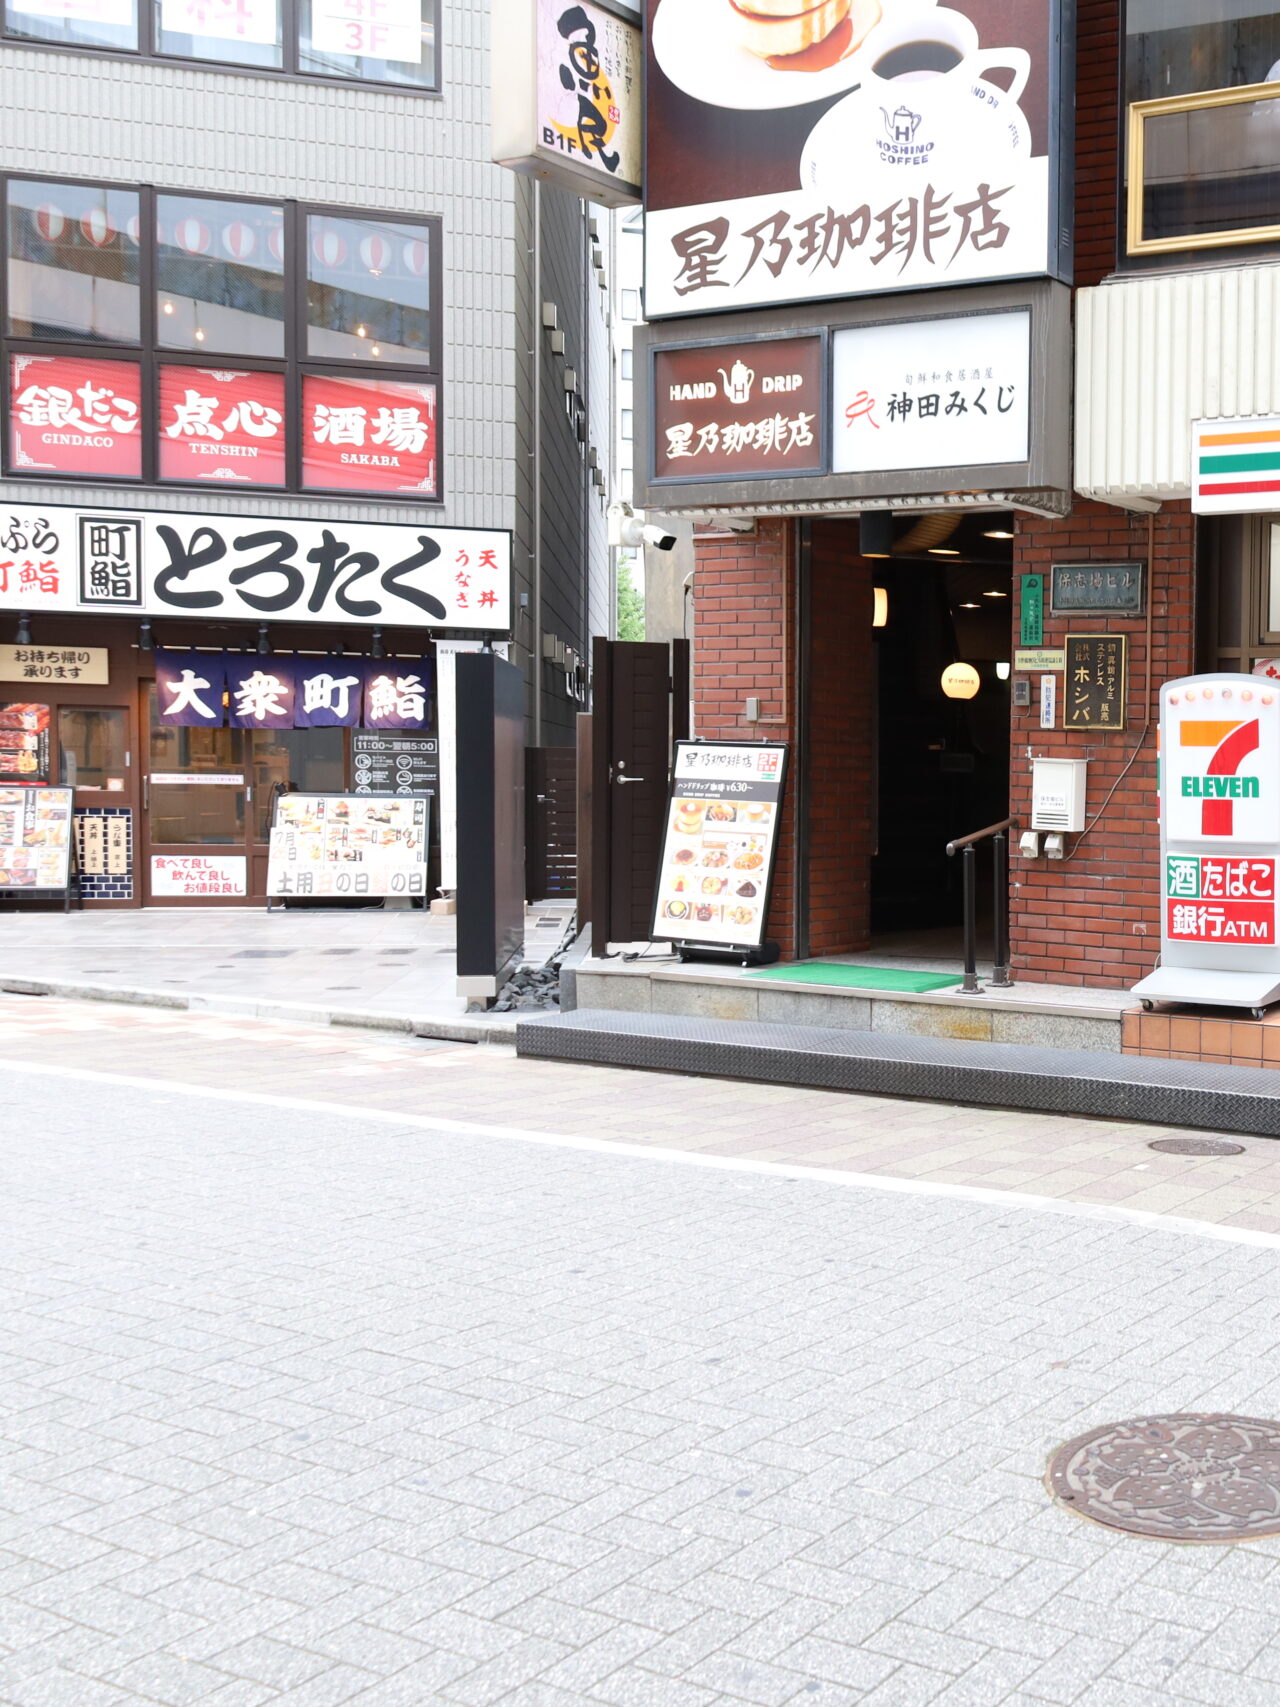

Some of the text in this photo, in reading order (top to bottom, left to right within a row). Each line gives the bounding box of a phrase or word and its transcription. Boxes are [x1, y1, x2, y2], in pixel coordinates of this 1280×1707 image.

[345, 23, 389, 52] 3F
[543, 126, 578, 154] B1F
[875, 138, 935, 156] HOSHINO
[880, 152, 929, 166] COFFEE
[670, 183, 1017, 296] 星乃珈琲店
[670, 381, 717, 401] HAND
[762, 374, 803, 394] DRIP
[885, 384, 1017, 424] 神田みくじ
[16, 380, 138, 434] 銀だこ
[165, 389, 283, 441] 点心
[41, 432, 114, 449] GINDACO
[312, 402, 430, 454] 酒場
[665, 411, 816, 459] 星乃珈琲店
[189, 442, 259, 458] TENSHIN
[340, 452, 401, 468] SAKABA
[89, 524, 132, 599] 町鮨
[153, 523, 448, 621] とろたく
[476, 549, 499, 609] 天丼
[13, 649, 91, 665] お持ち帰り
[23, 665, 82, 680] 承ります
[1096, 643, 1105, 685] ステンレス
[163, 668, 428, 722] 大衆町鮨
[1073, 666, 1091, 721] ホシバ
[685, 752, 753, 768] 星乃珈琲店
[760, 754, 778, 767] 2F
[1180, 718, 1260, 836] 7
[89, 823, 98, 839] 天丼
[184, 882, 244, 893] お値段良し
[1168, 858, 1198, 897] 酒
[1202, 860, 1273, 898] たばこ
[1172, 905, 1268, 939] 銀行ATM
